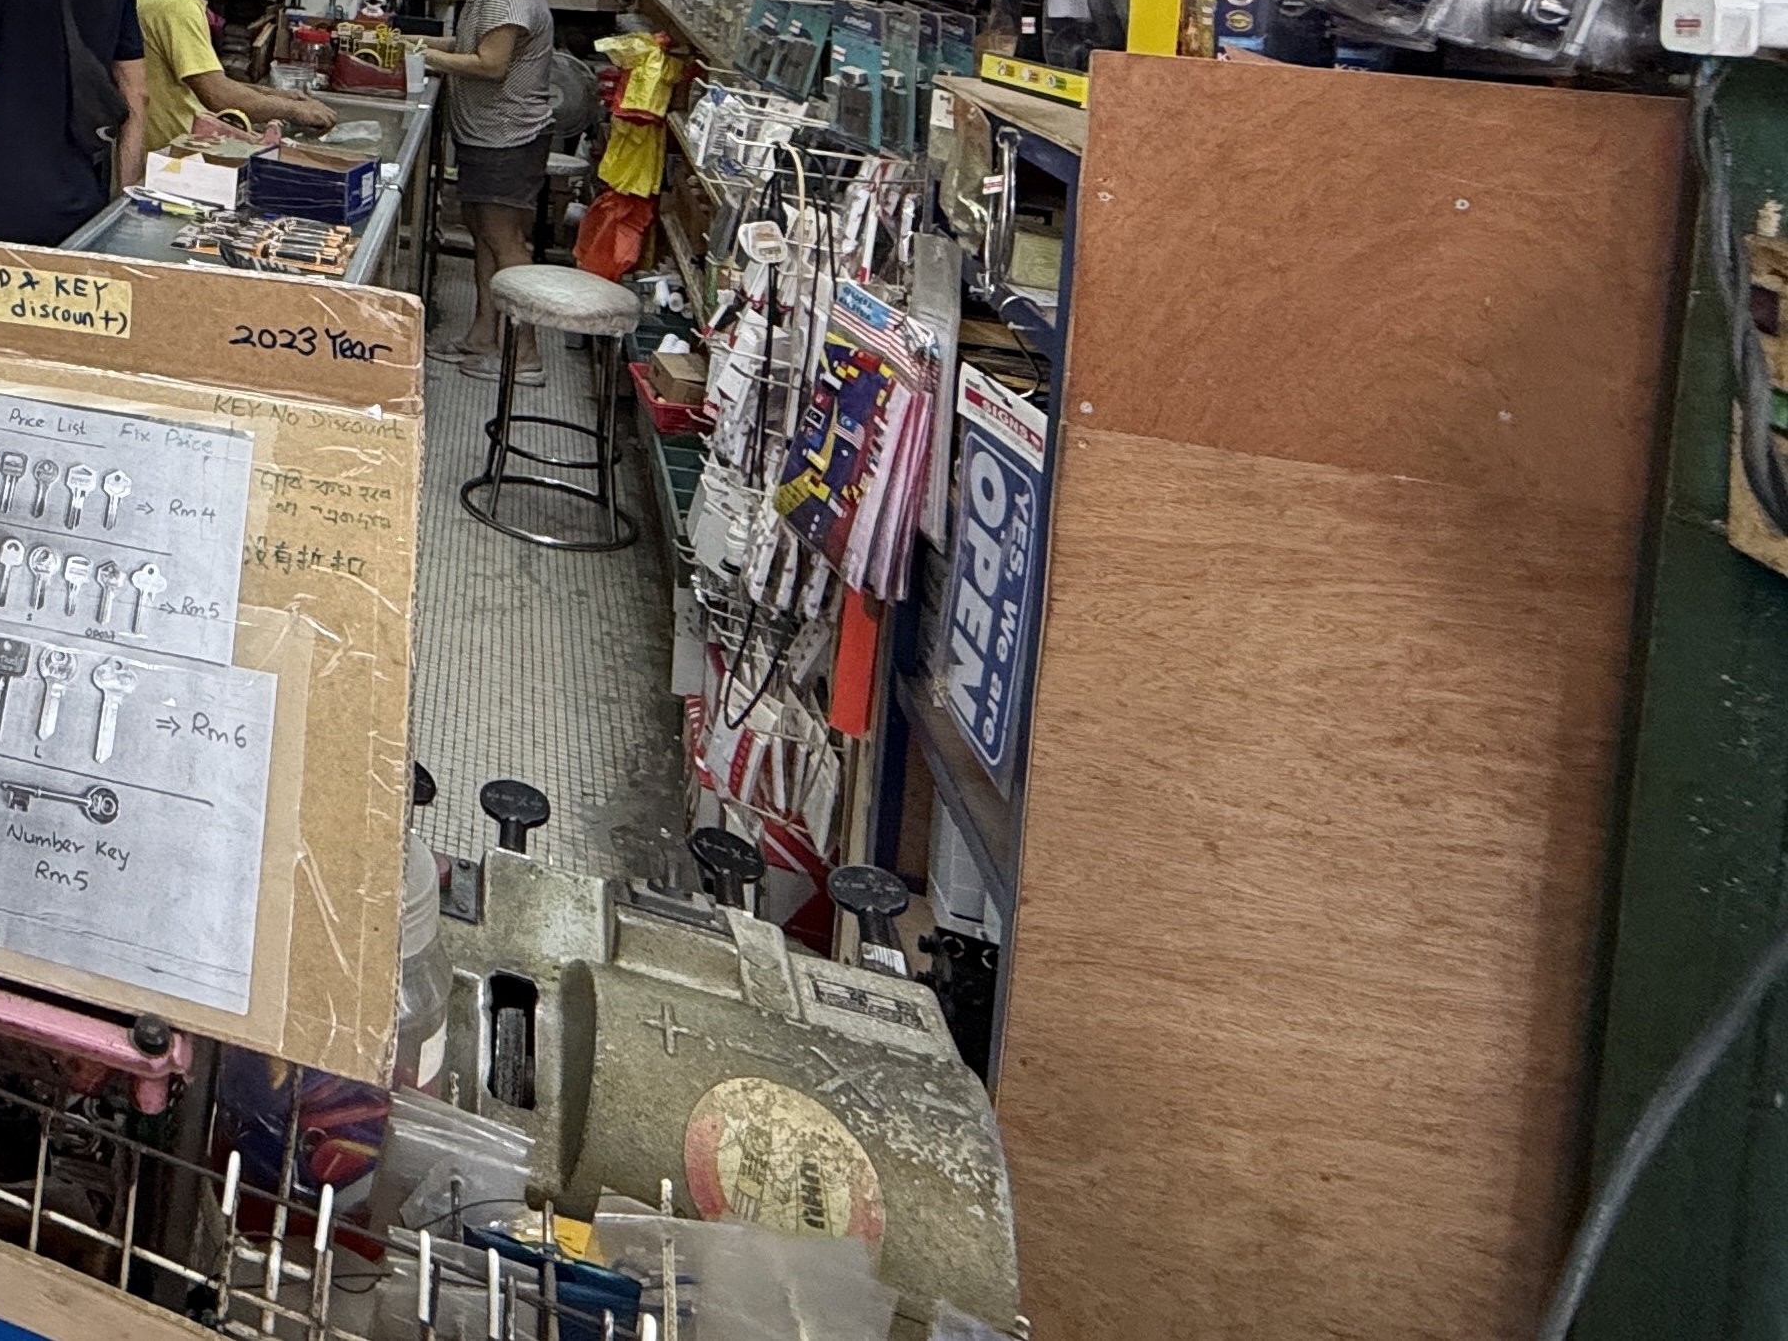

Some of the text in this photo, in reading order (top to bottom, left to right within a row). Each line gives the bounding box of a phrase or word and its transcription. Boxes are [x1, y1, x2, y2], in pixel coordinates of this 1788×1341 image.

[11, 295, 129, 336] discount)
[54, 276, 111, 311] KEY
[229, 324, 394, 365] 2023 Year
[9, 407, 50, 433] Price
[56, 416, 88, 438] List
[164, 428, 215, 456] Price
[213, 393, 408, 440] KEY No Discount
[980, 398, 1030, 441] SIGNS
[1008, 490, 1031, 585] YES,
[948, 449, 1009, 730] OPEN
[982, 669, 1004, 747] are
[6, 823, 131, 872] Number Key
